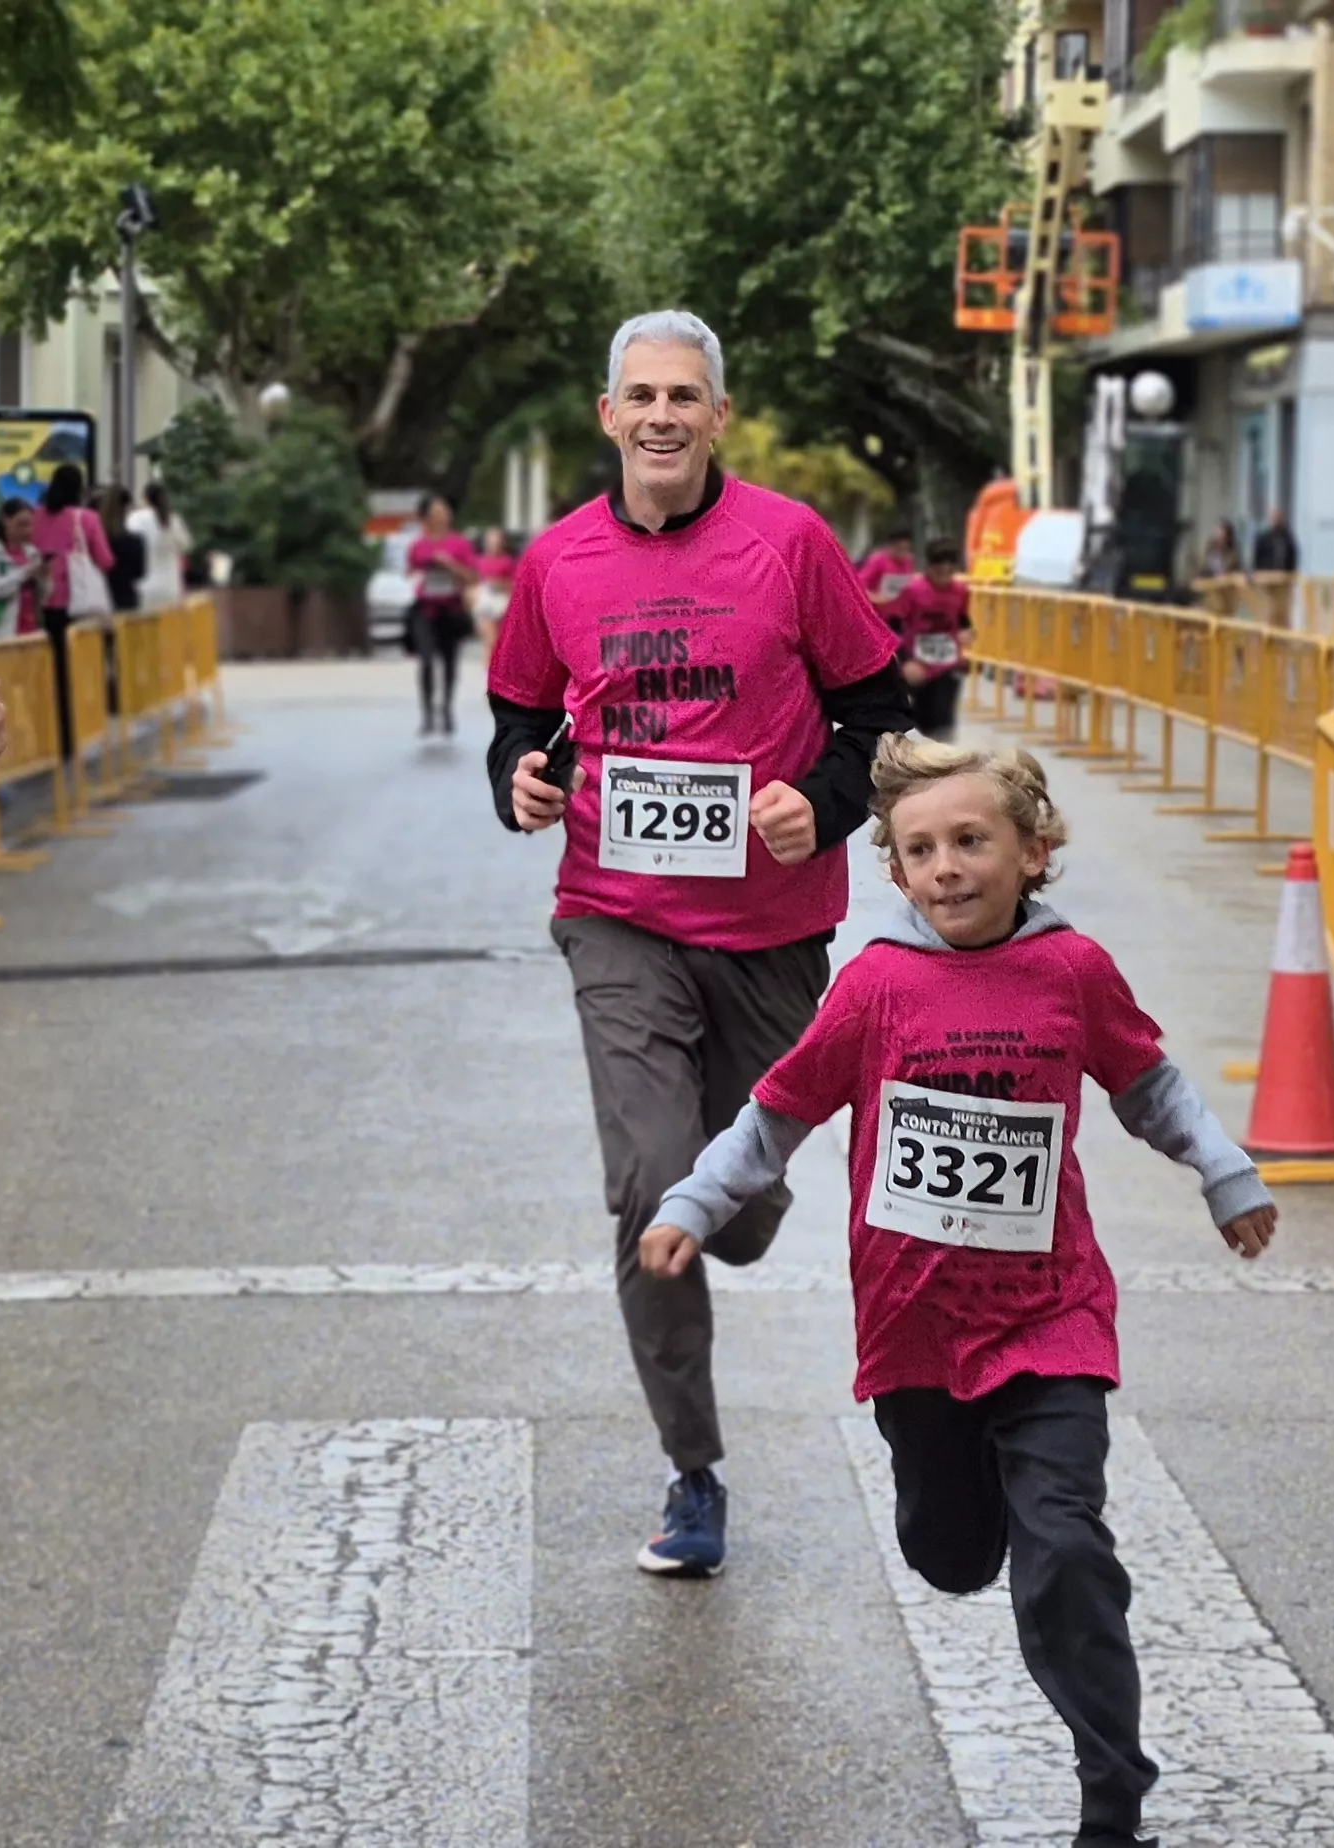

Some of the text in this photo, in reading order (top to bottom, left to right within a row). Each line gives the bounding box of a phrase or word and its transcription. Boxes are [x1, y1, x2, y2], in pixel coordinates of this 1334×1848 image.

[636, 664, 737, 702] EN CADA
[600, 705, 667, 744] PASO
[616, 779, 732, 797] CONTRA EL CÁNCER
[616, 798, 732, 842] 1298
[900, 1112, 1044, 1146] CONTRA EL CÁNCER
[951, 1110, 998, 1129] HUESCA
[892, 1136, 1040, 1207] 3321
